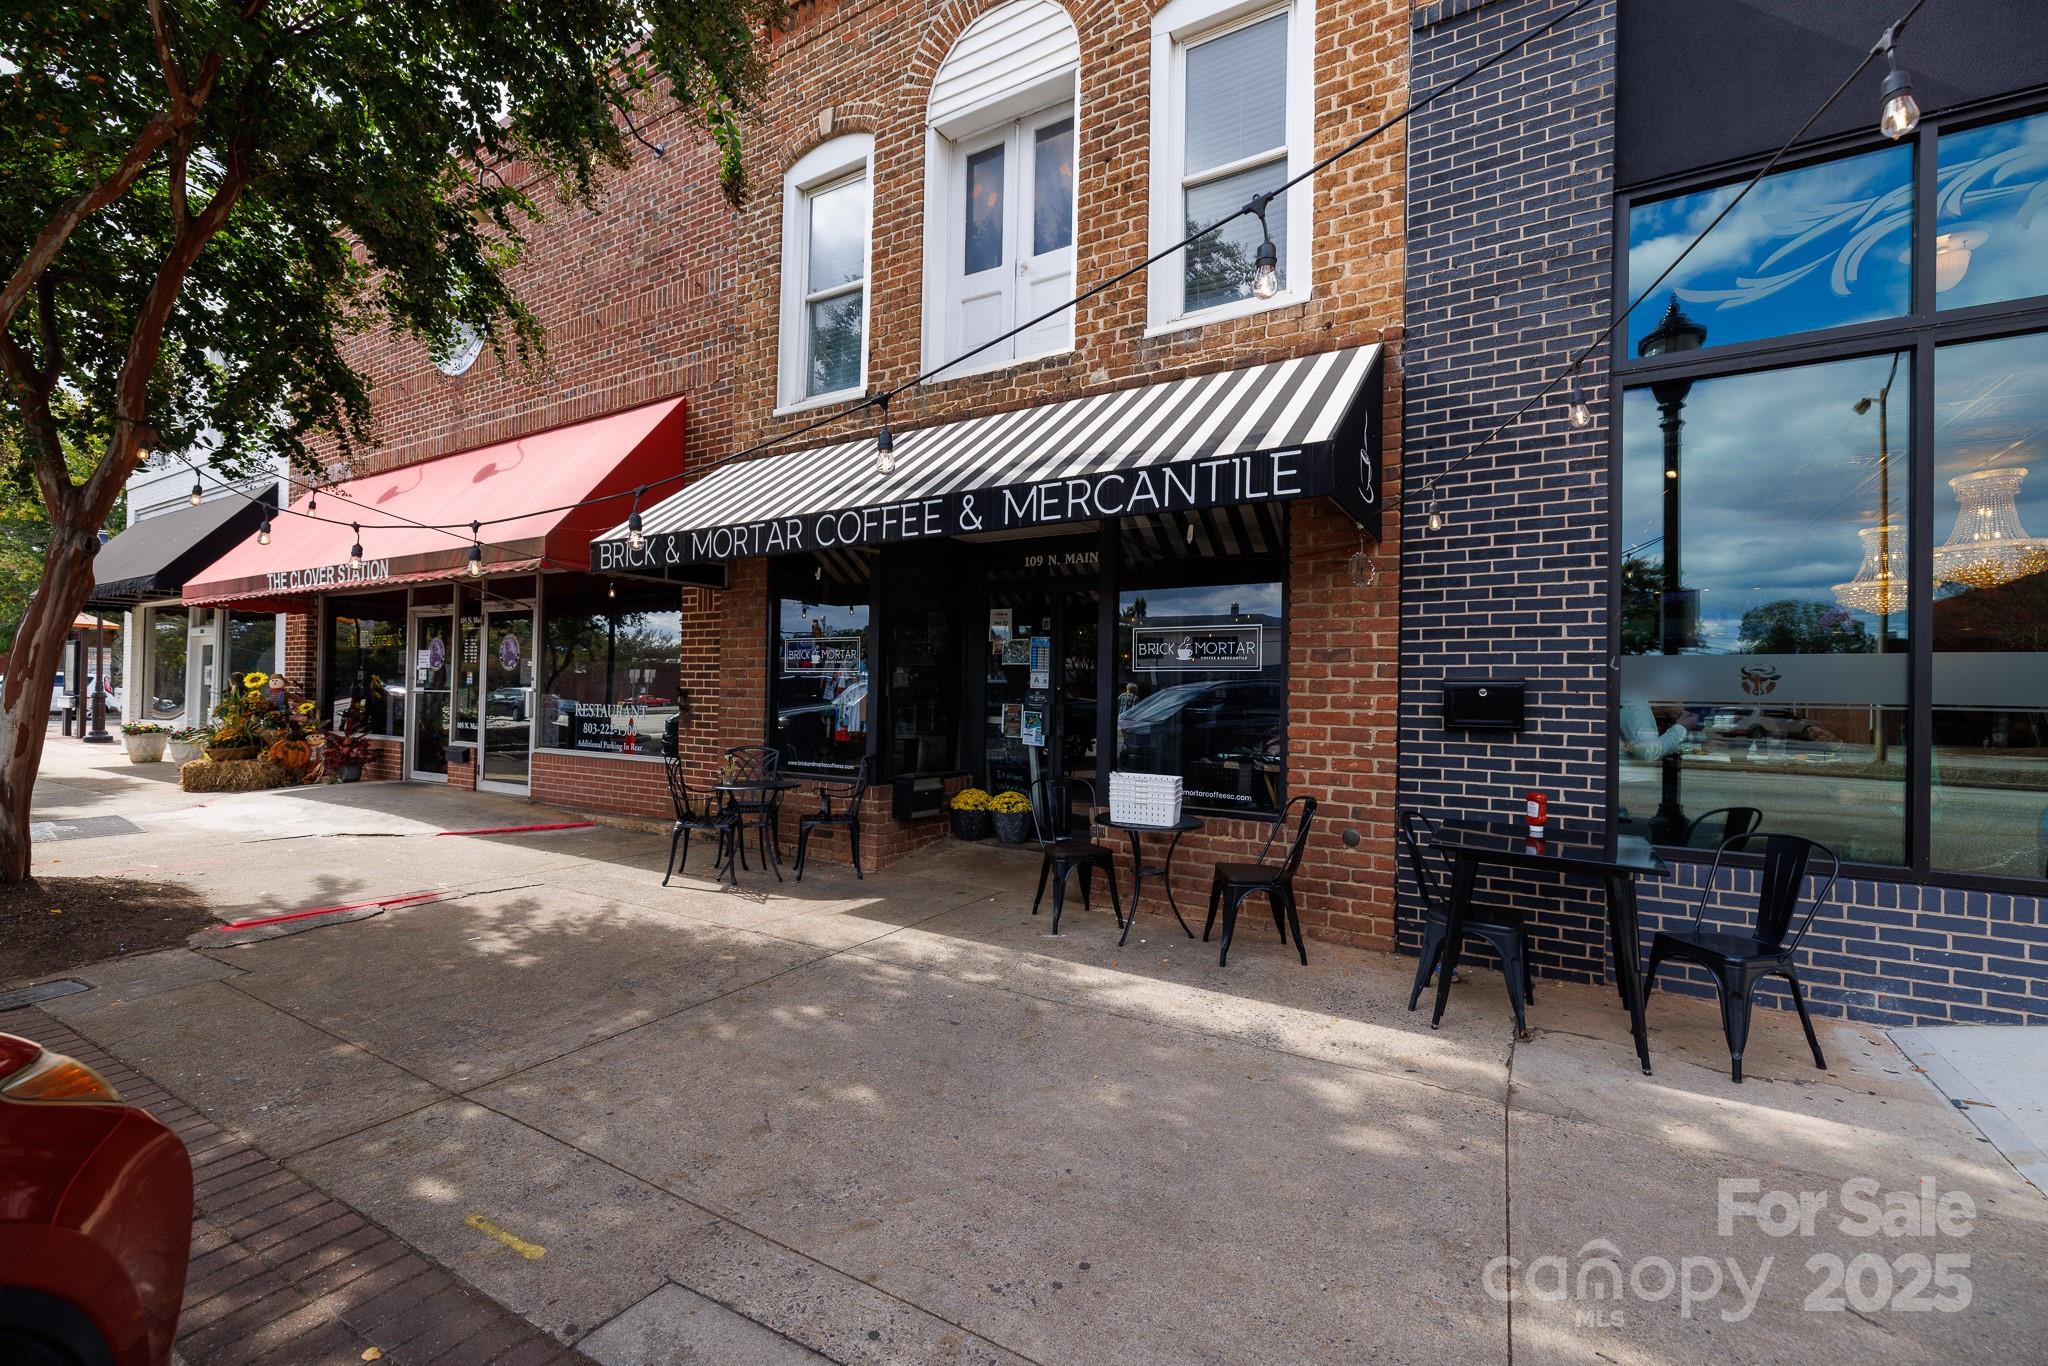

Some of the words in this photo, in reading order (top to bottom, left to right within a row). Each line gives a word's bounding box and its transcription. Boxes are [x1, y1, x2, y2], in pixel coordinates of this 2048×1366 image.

[600, 540, 656, 570] BRICK
[665, 537, 680, 564] &
[691, 519, 803, 562] MORTAR
[815, 498, 944, 547] COFFEE
[959, 495, 983, 530] &
[1002, 450, 1302, 526] MERCANTILE
[1024, 555, 1044, 567] 109
[1047, 554, 1061, 566] N.
[1065, 551, 1099, 565] MAIN
[266, 572, 288, 591] THE
[290, 565, 335, 589] CLOVER
[338, 559, 389, 583] STATION
[788, 649, 811, 660] BRICK
[821, 649, 857, 660] MORTAR
[1137, 642, 1175, 656] BRICK
[1194, 641, 1256, 655] MORTAR
[575, 703, 648, 720] RESTAURANT
[582, 722, 637, 737] 803-222-1500
[577, 739, 603, 749] Additional
[603, 741, 623, 752] Parking
[623, 742, 630, 751] In
[630, 743, 643, 752] Rear
[1182, 790, 1252, 802] mortarcoffeesc.com
